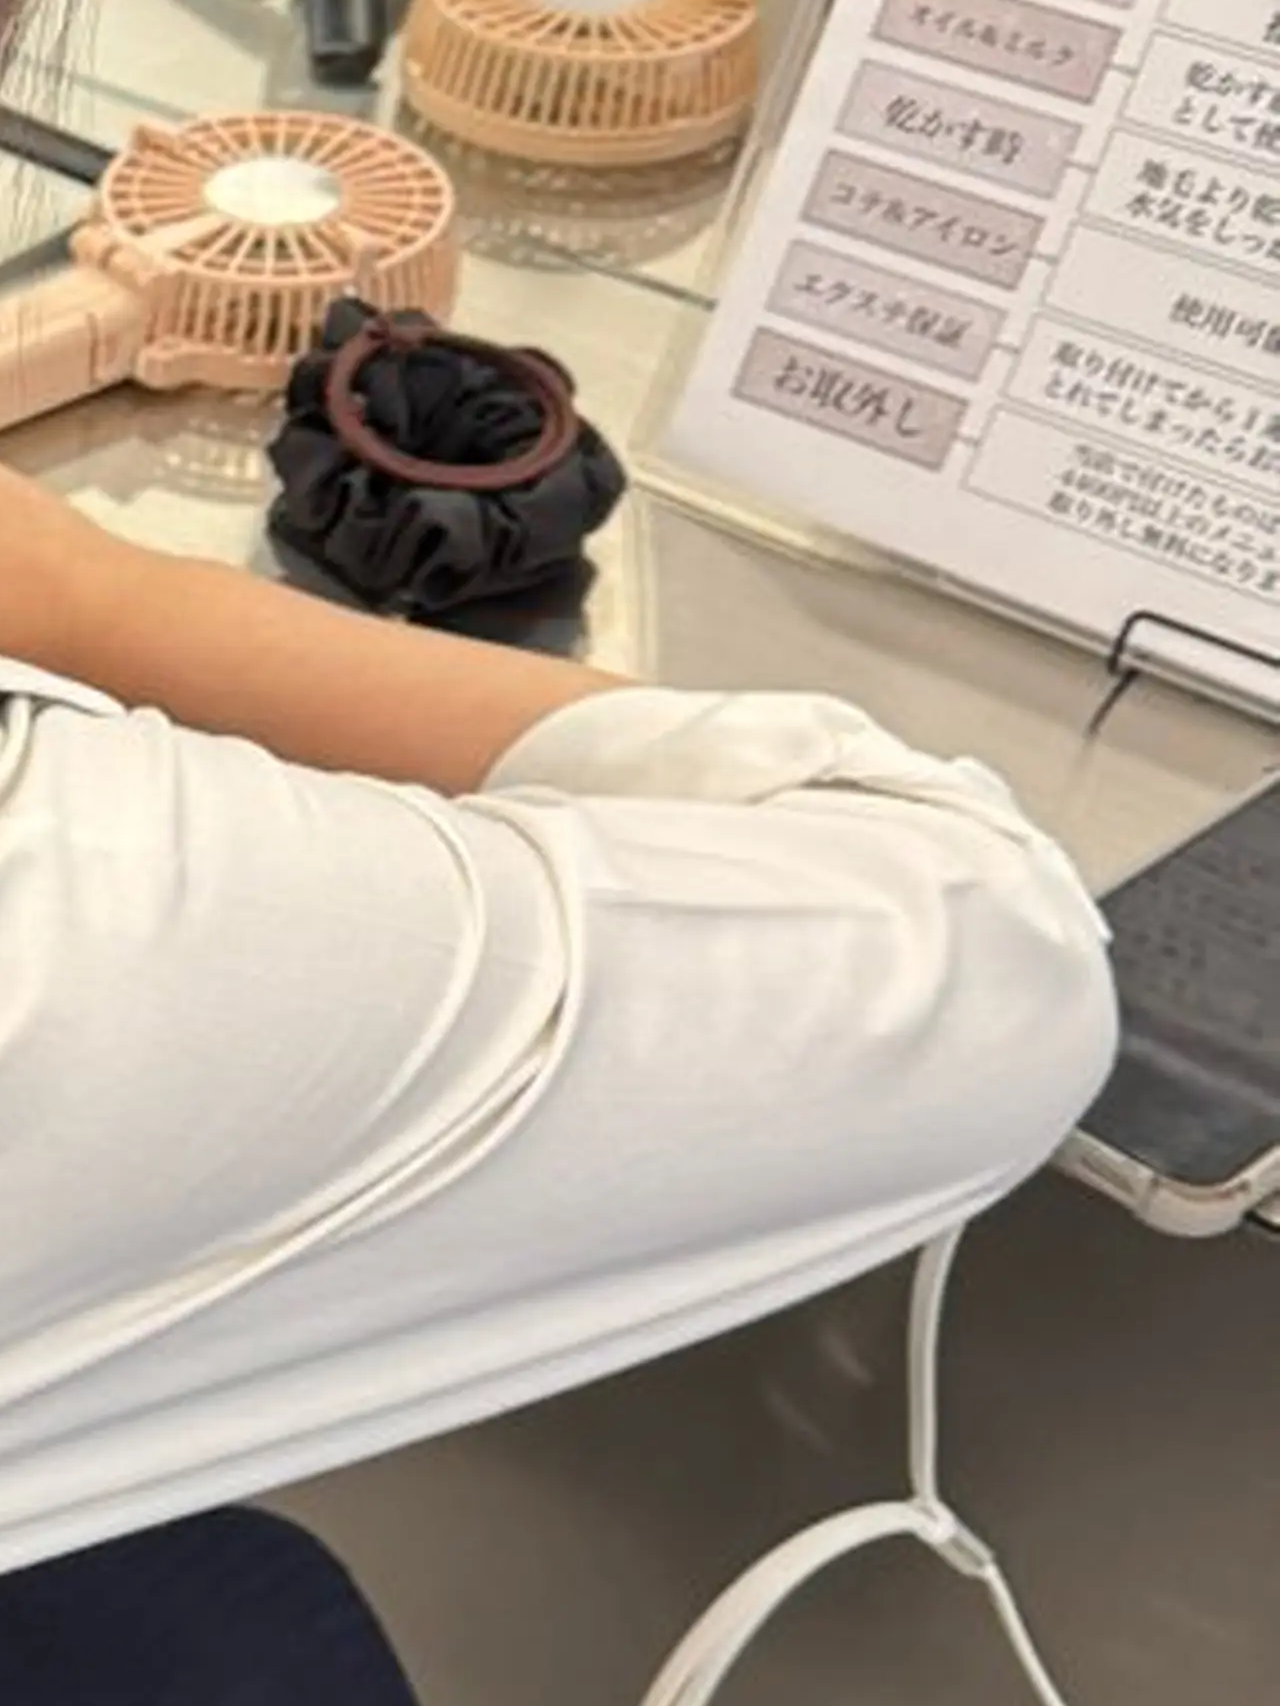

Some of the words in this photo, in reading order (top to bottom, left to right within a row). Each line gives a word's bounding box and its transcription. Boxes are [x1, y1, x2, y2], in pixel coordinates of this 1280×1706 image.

[884, 94, 1026, 165] 乾かす時
[773, 355, 925, 439] お取外し
